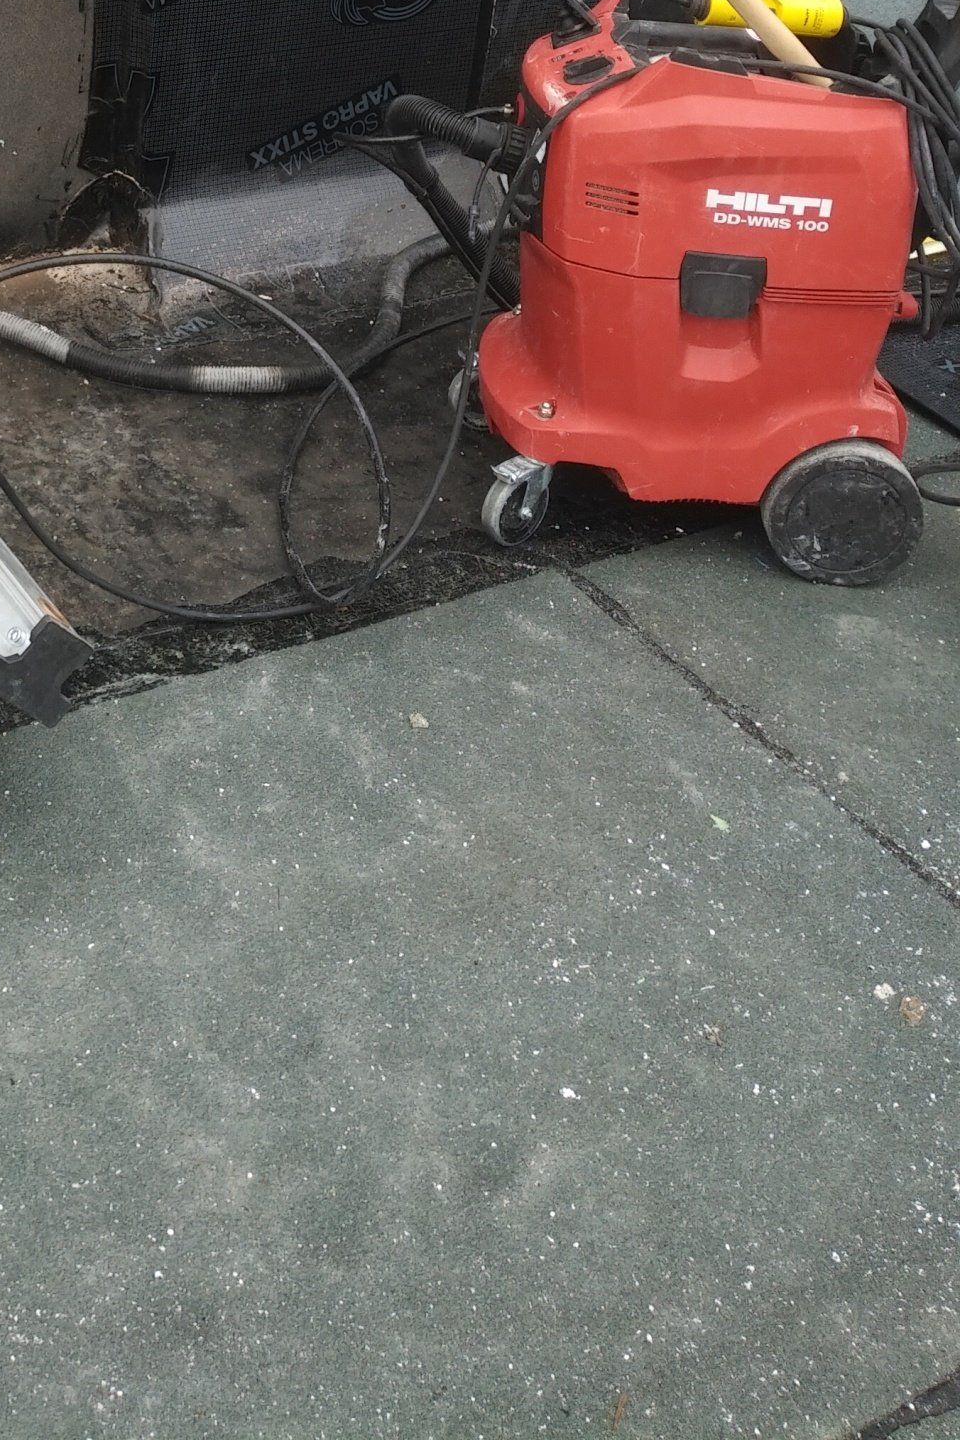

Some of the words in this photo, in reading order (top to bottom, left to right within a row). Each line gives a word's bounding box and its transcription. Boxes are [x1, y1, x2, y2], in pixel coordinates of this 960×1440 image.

[323, 79, 400, 131] VAPRO
[249, 119, 318, 170] STIXX
[706, 188, 834, 218] HILTI
[713, 212, 792, 230] DD-WMS
[796, 220, 829, 233] 100
